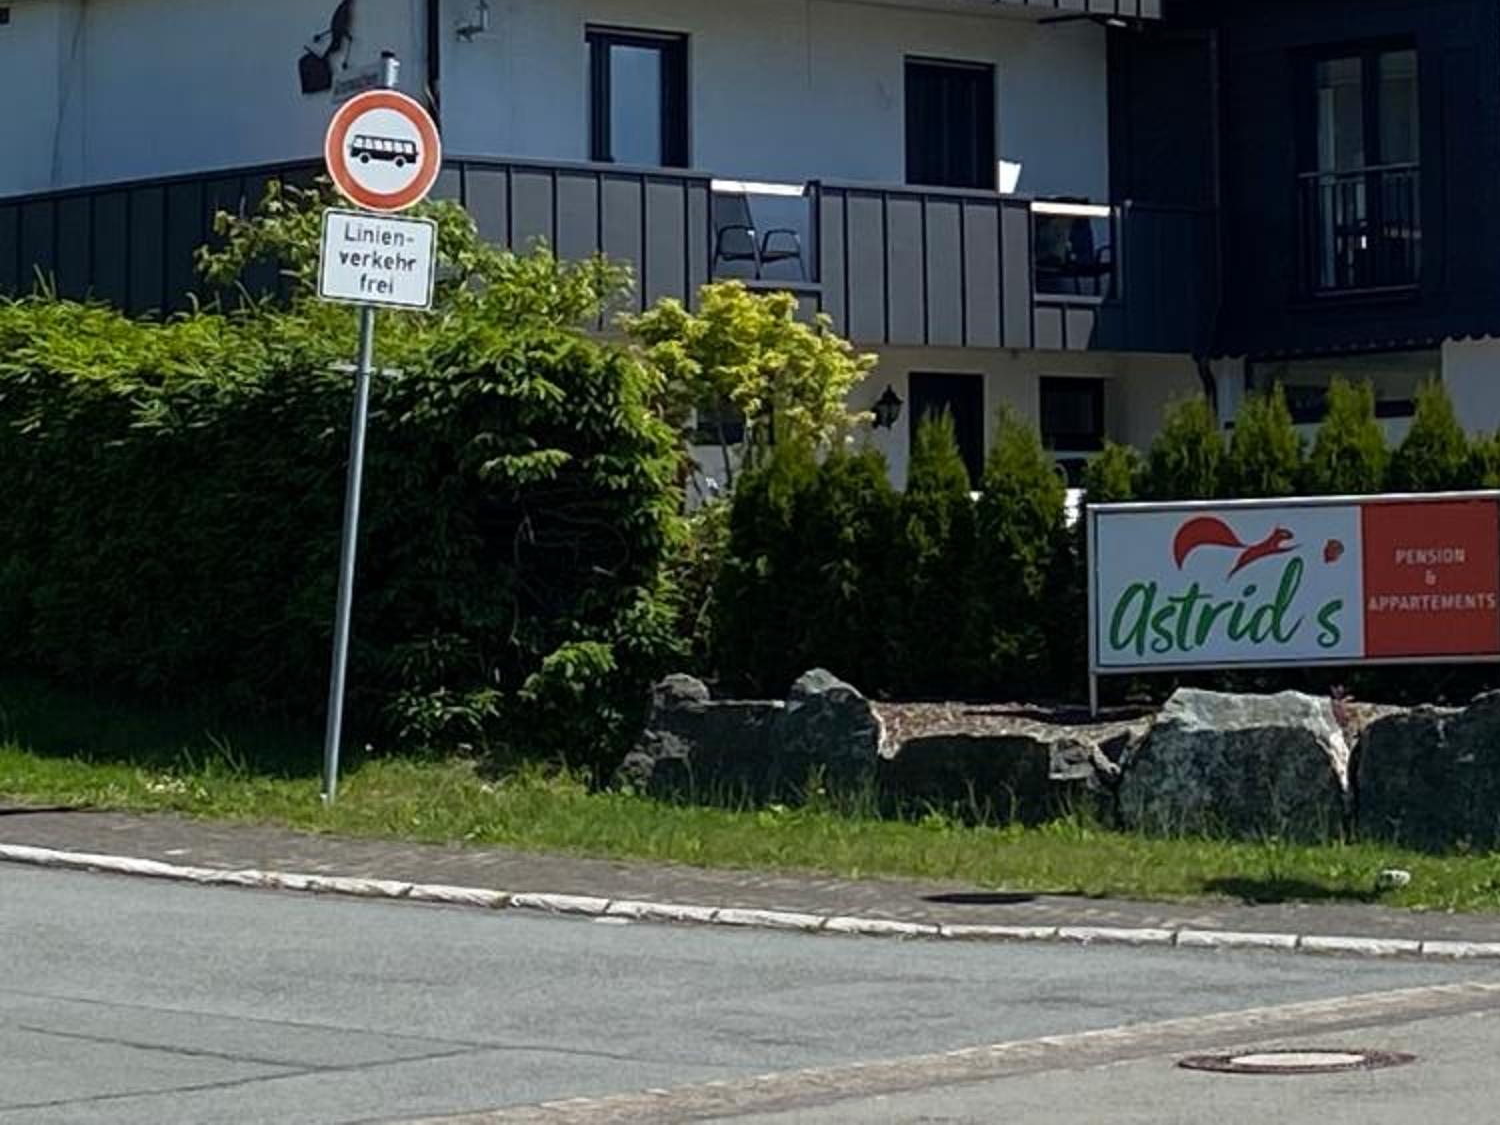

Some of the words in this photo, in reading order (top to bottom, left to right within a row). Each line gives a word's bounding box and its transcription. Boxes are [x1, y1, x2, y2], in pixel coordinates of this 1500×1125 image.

[344, 222, 415, 248] Linien-
[339, 250, 417, 272] verkehr
[360, 273, 393, 294] frei
[1395, 548, 1465, 565] PENSION
[1424, 570, 1436, 586] &
[1368, 592, 1496, 611] APPARTEMENTS
